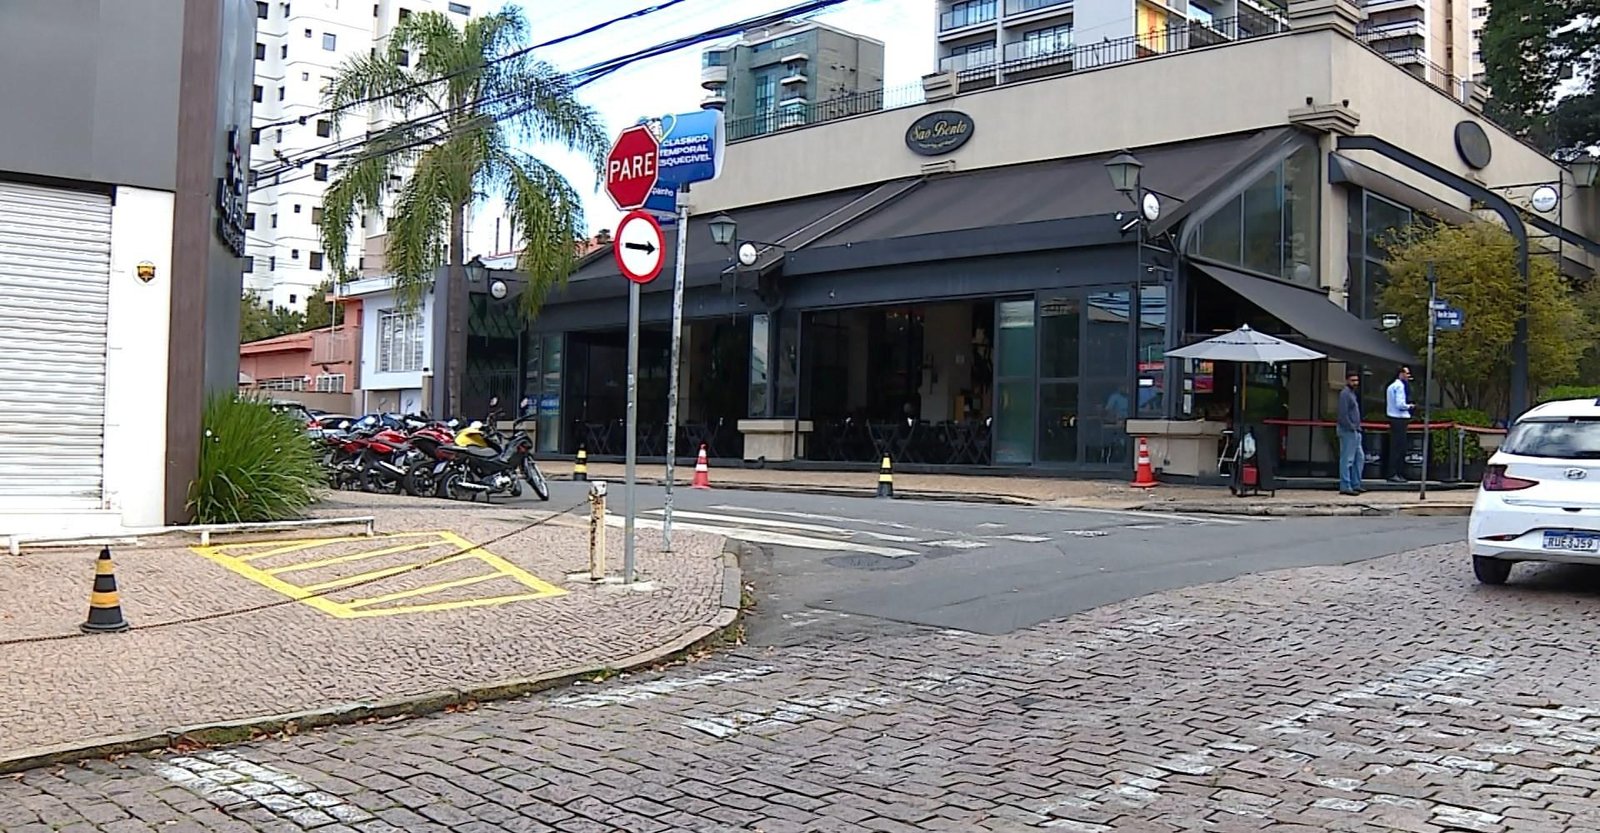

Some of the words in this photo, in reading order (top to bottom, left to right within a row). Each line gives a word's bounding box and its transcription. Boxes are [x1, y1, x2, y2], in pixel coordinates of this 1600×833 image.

[933, 120, 967, 136] Bento
[659, 144, 709, 157] TEMPORAL
[609, 152, 654, 183] PARE
